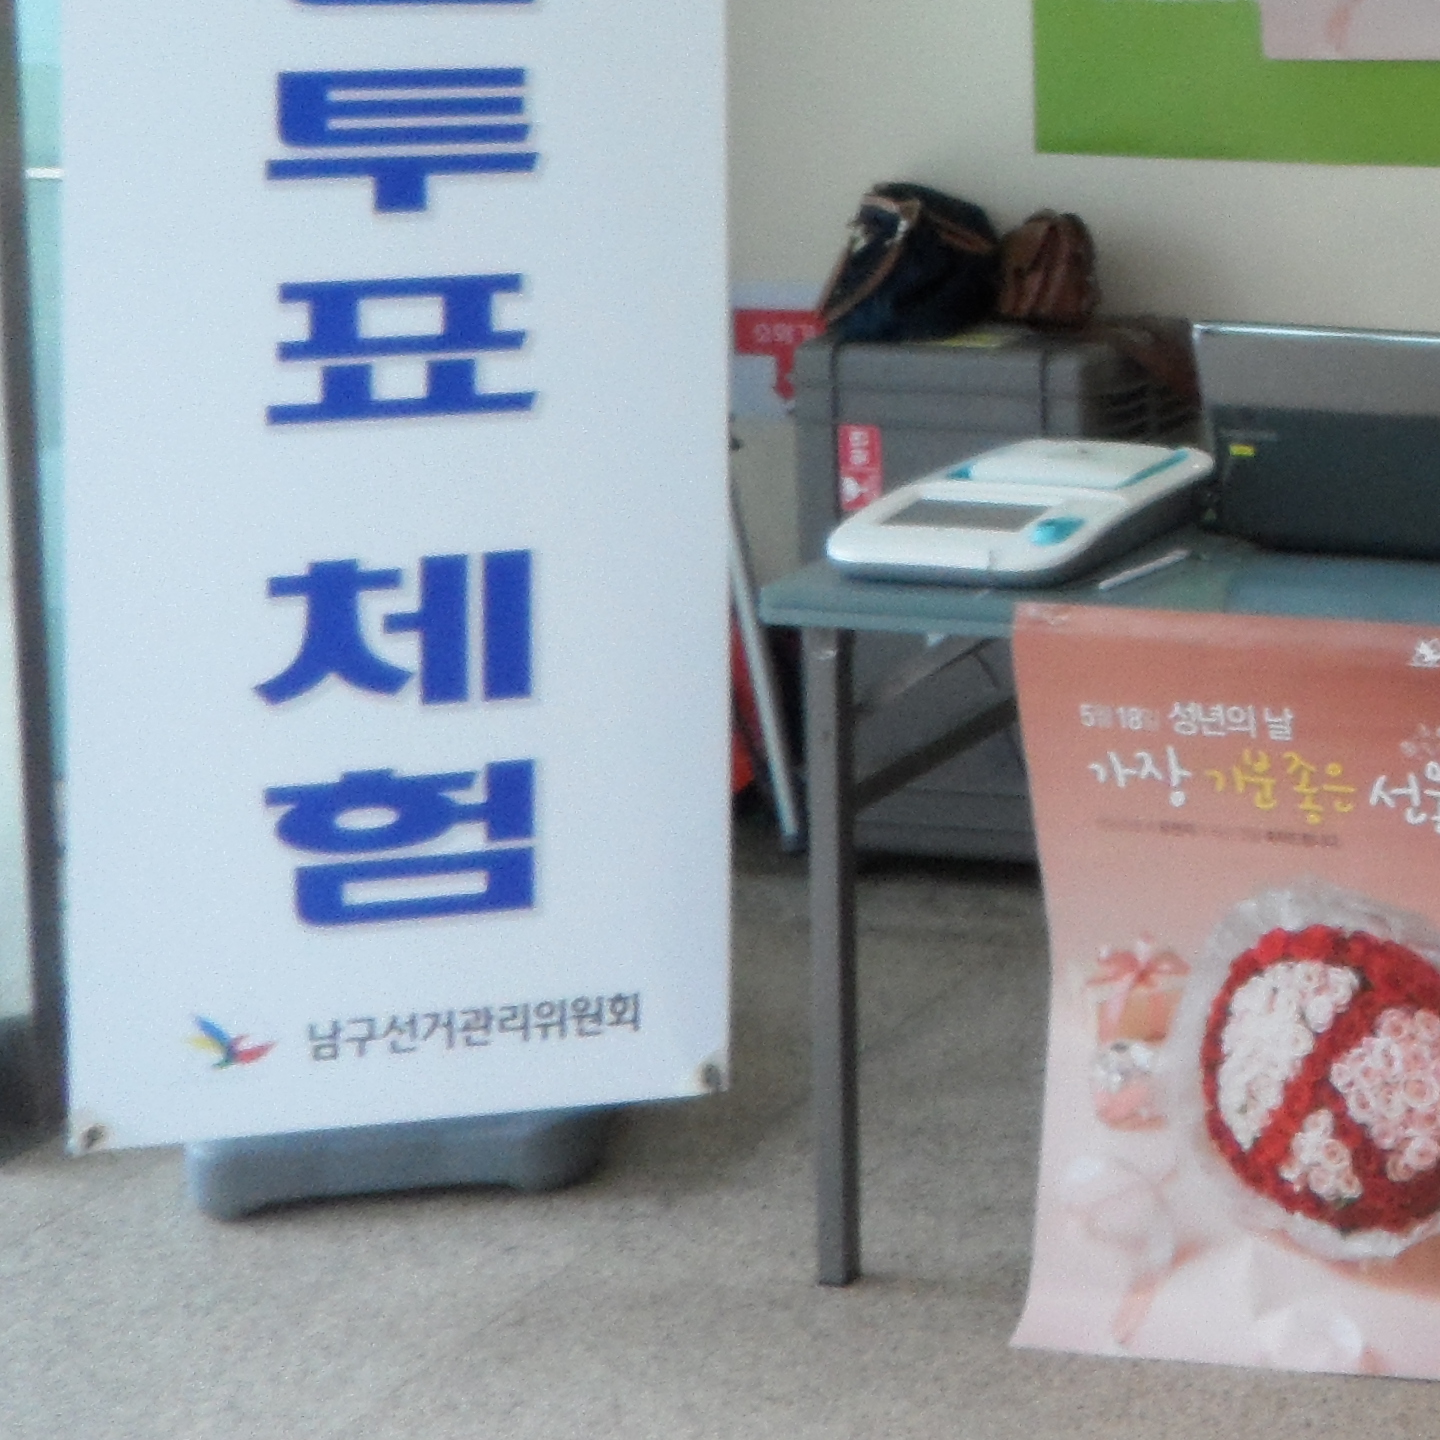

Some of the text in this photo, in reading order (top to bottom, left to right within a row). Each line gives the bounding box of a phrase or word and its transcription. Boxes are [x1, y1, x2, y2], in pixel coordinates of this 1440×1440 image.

[254, 549, 536, 929] 체험
[1169, 702, 1257, 739] 성년의
[1265, 707, 1294, 742] 날
[1089, 746, 1192, 807] 가장
[307, 991, 642, 1061] 남구선거관리위원회
